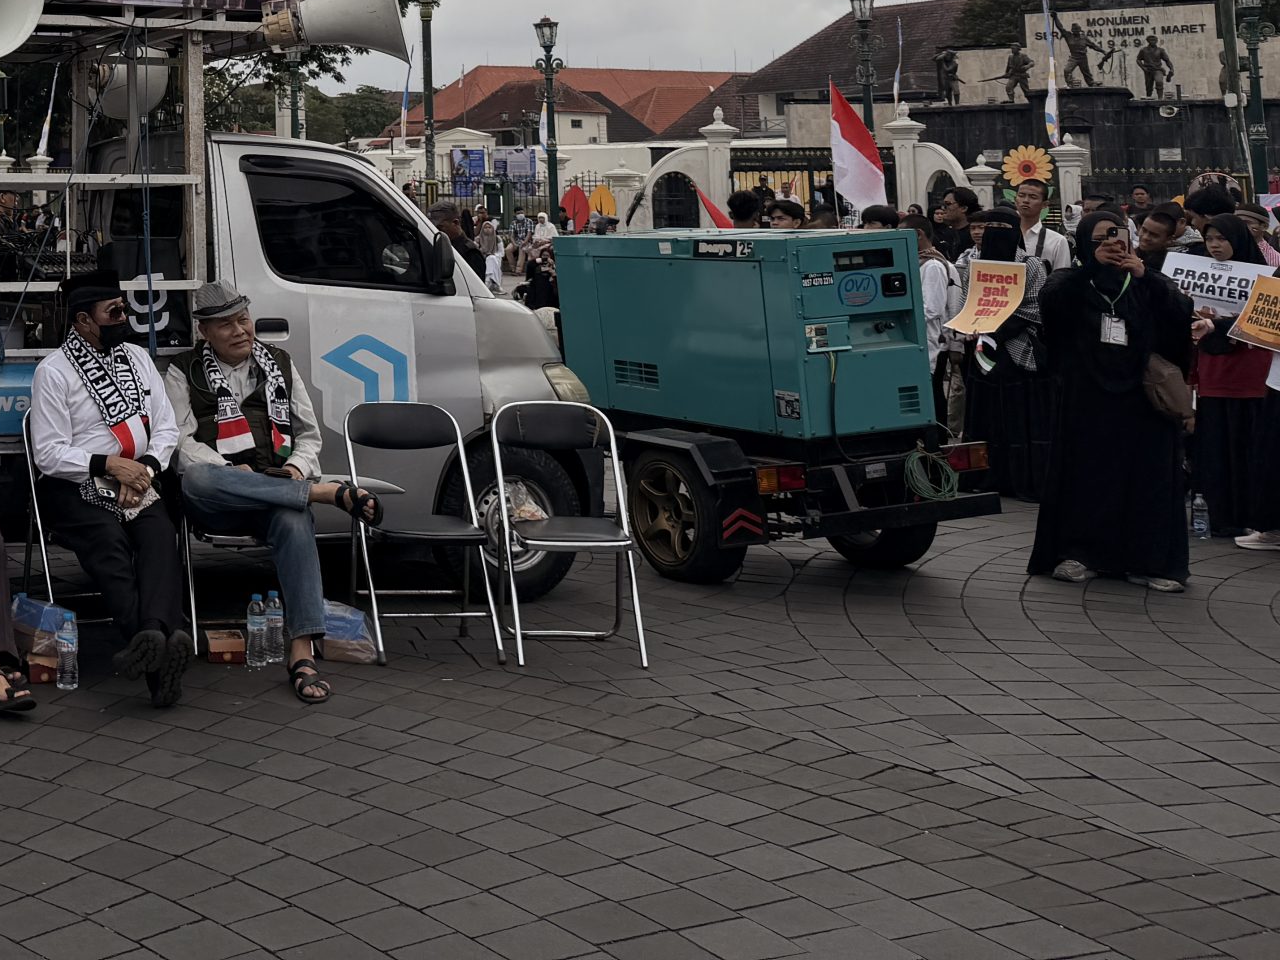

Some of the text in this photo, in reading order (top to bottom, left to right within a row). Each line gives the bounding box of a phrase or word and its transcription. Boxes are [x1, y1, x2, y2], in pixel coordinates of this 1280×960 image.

[1087, 15, 1150, 27] MONUMEN
[1109, 27, 1145, 37] UMUM
[1151, 27, 1157, 35] 1
[1161, 24, 1206, 35] MARET
[976, 271, 1018, 285] israel
[1173, 268, 1223, 284] PRAY
[983, 285, 1009, 297] gak
[1175, 279, 1249, 301] UMATER
[977, 297, 1010, 308] tahu
[1256, 292, 1280, 310] PRA
[974, 308, 1002, 316] diri
